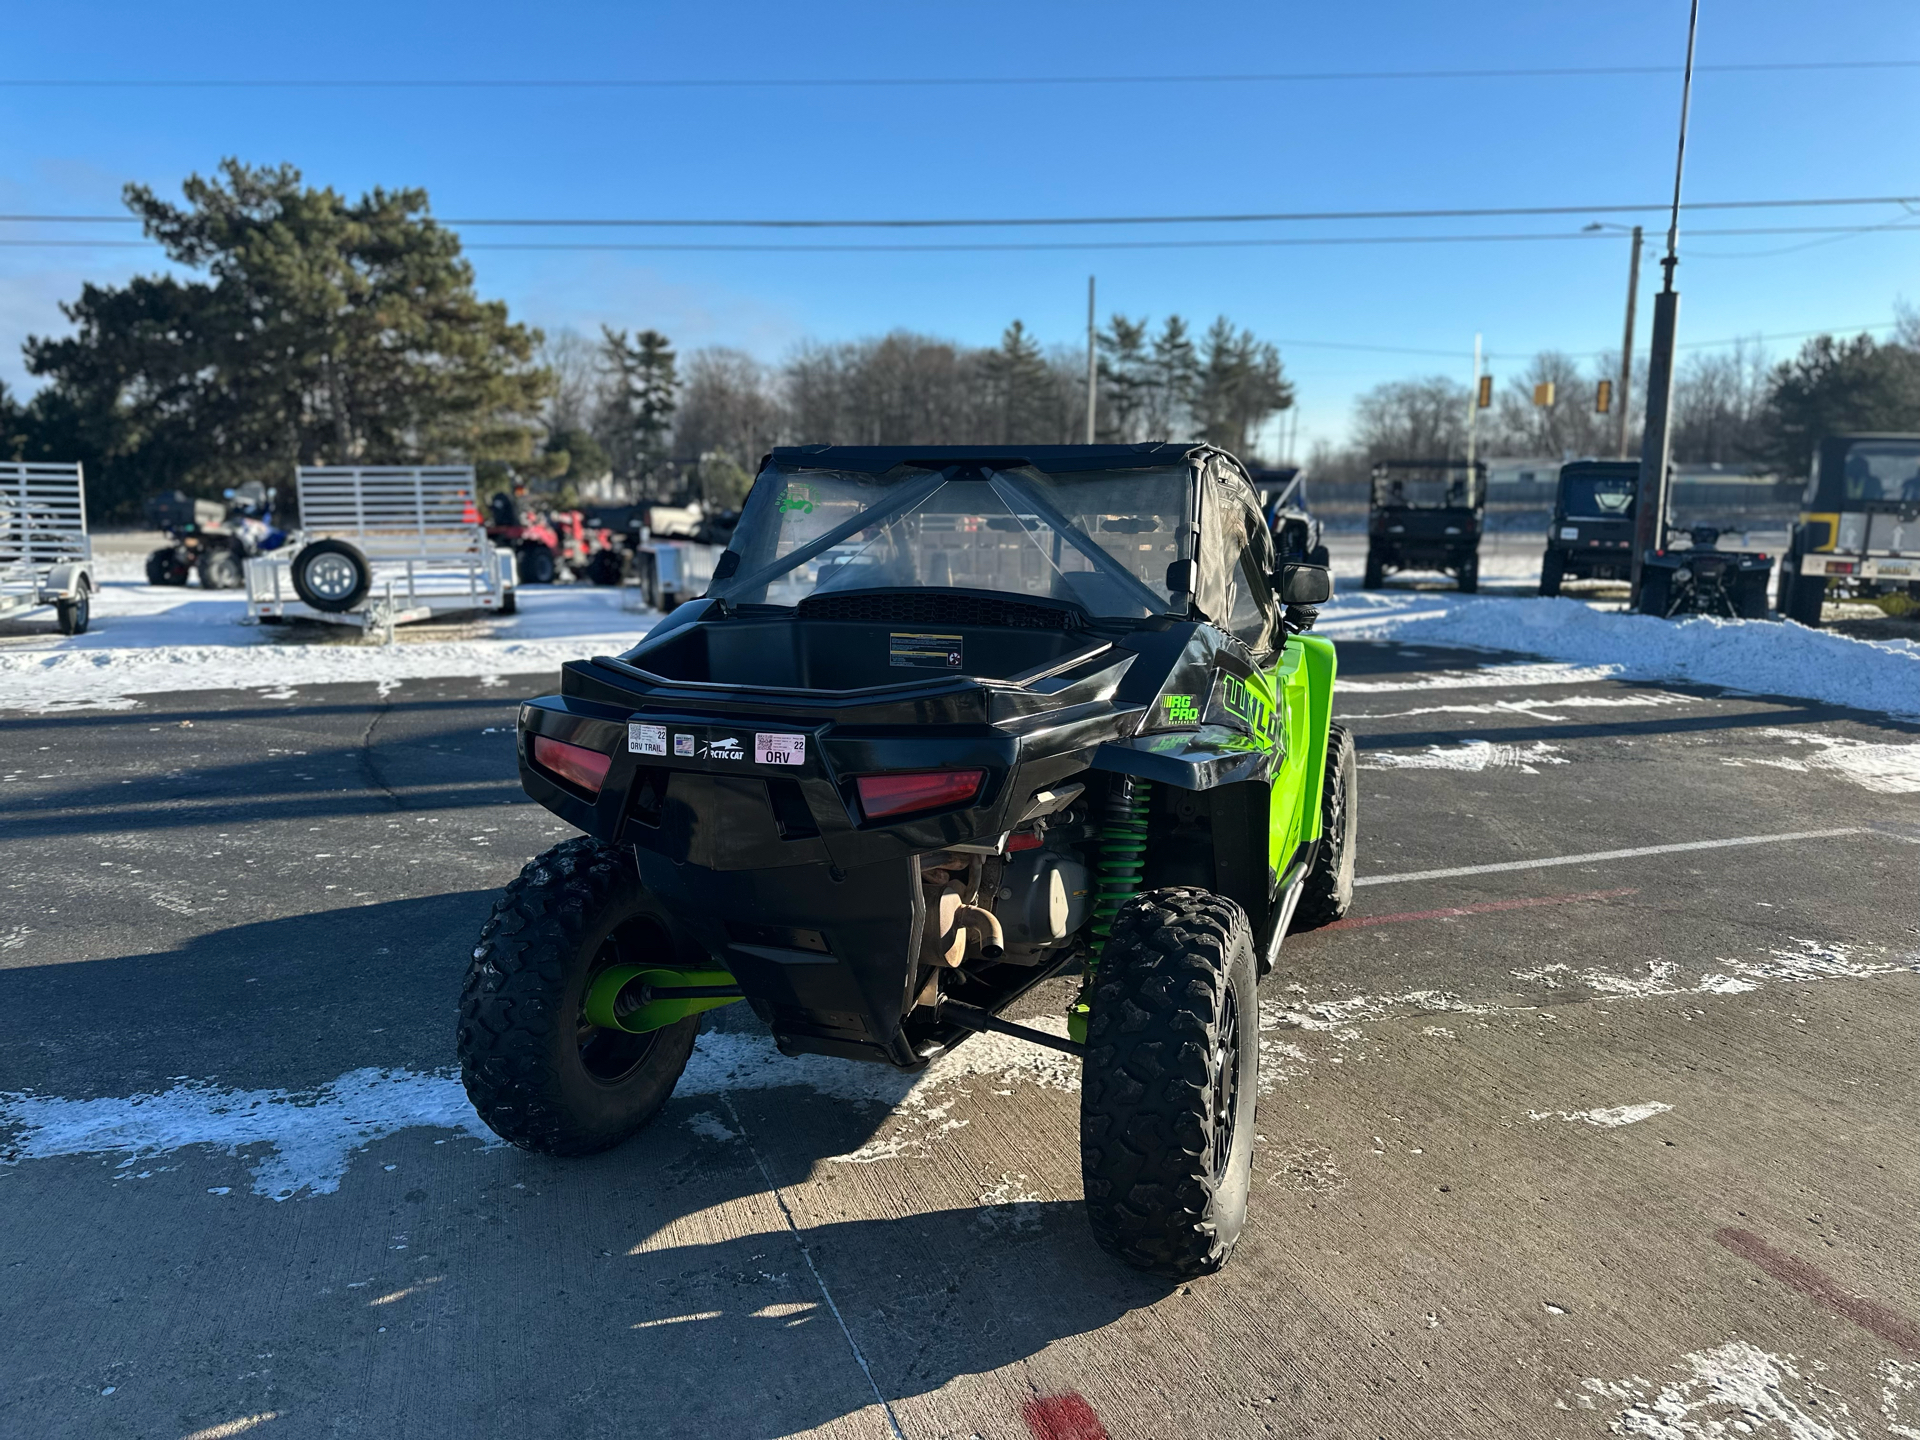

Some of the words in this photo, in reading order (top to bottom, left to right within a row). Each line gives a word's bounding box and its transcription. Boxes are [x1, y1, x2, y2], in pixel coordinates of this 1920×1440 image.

[1169, 708, 1198, 720] PRO
[657, 731, 666, 740] 22
[630, 741, 643, 751] ORV
[645, 743, 663, 753] TRAIL
[793, 741, 804, 750] 22
[696, 747, 729, 760] ARCTIC
[729, 750, 744, 760] CAT
[765, 751, 790, 764] ORV
